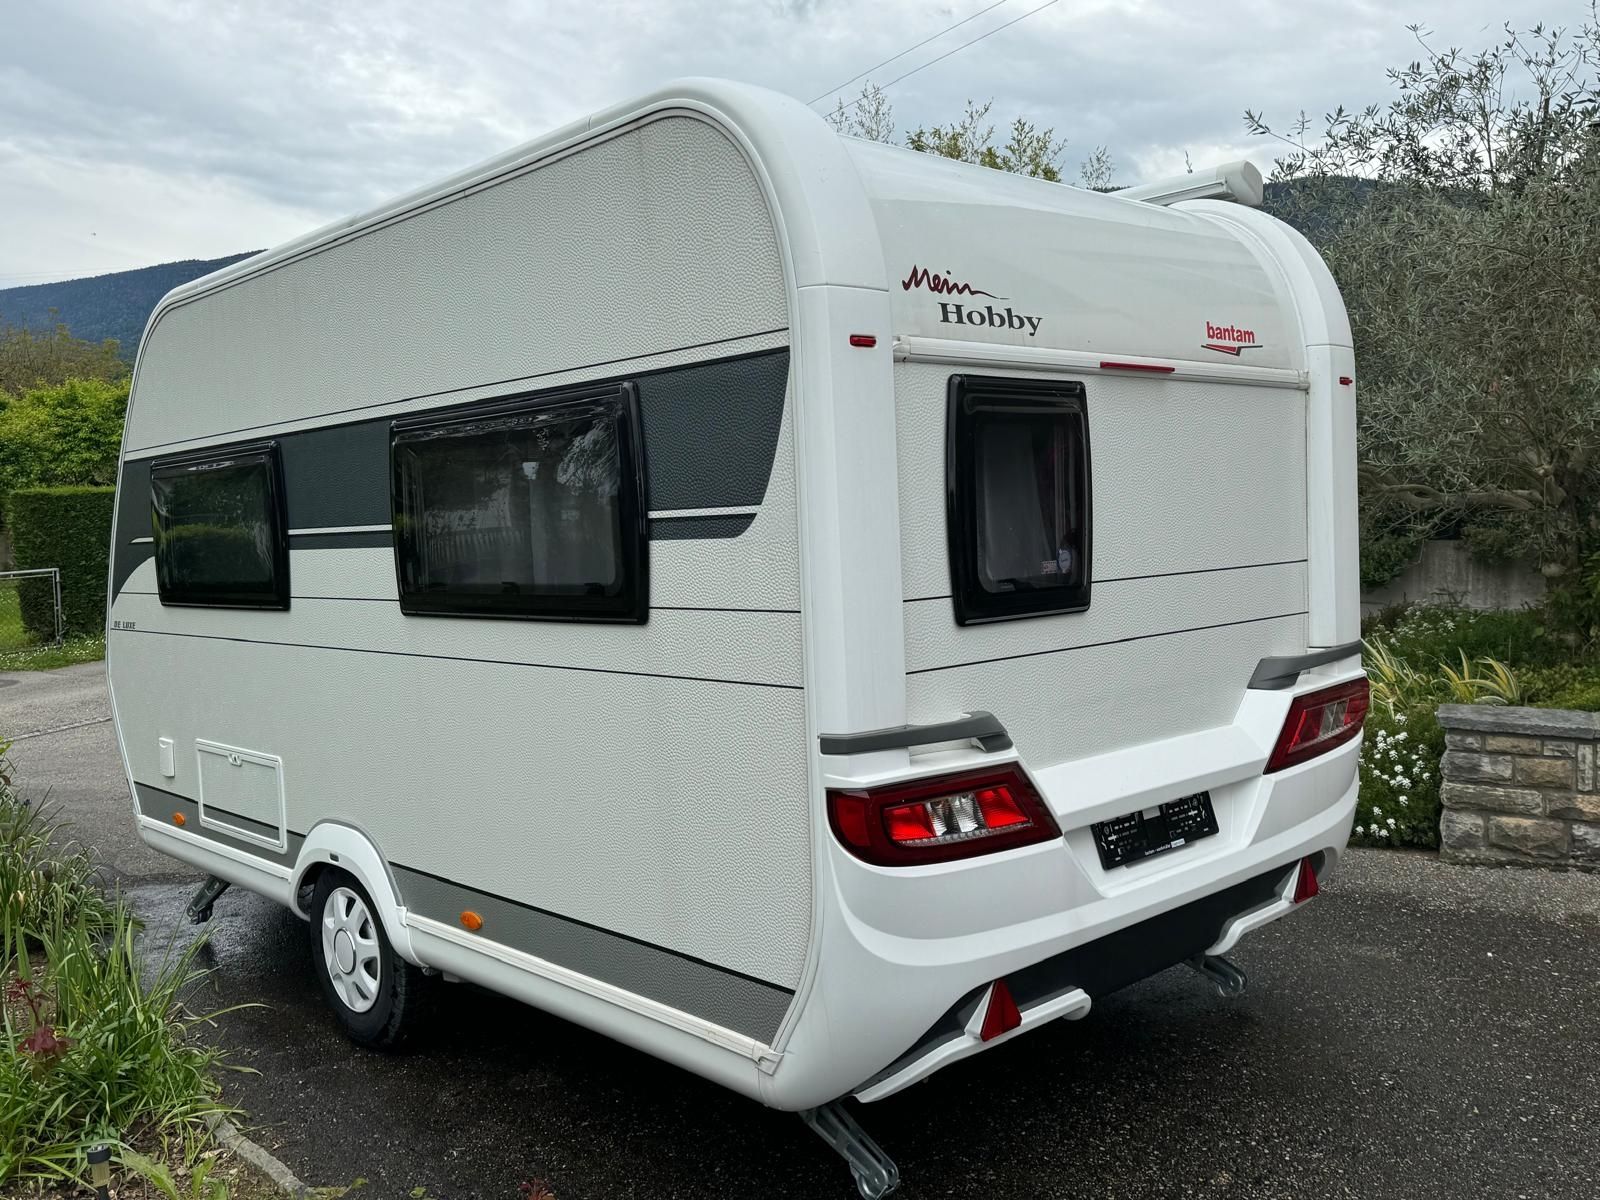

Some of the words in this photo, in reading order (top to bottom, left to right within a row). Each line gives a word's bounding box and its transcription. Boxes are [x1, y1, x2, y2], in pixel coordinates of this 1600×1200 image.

[902, 264, 1010, 300] Mein
[937, 302, 1043, 336] Hobby
[1206, 321, 1255, 344] bantam
[114, 620, 121, 628] DE
